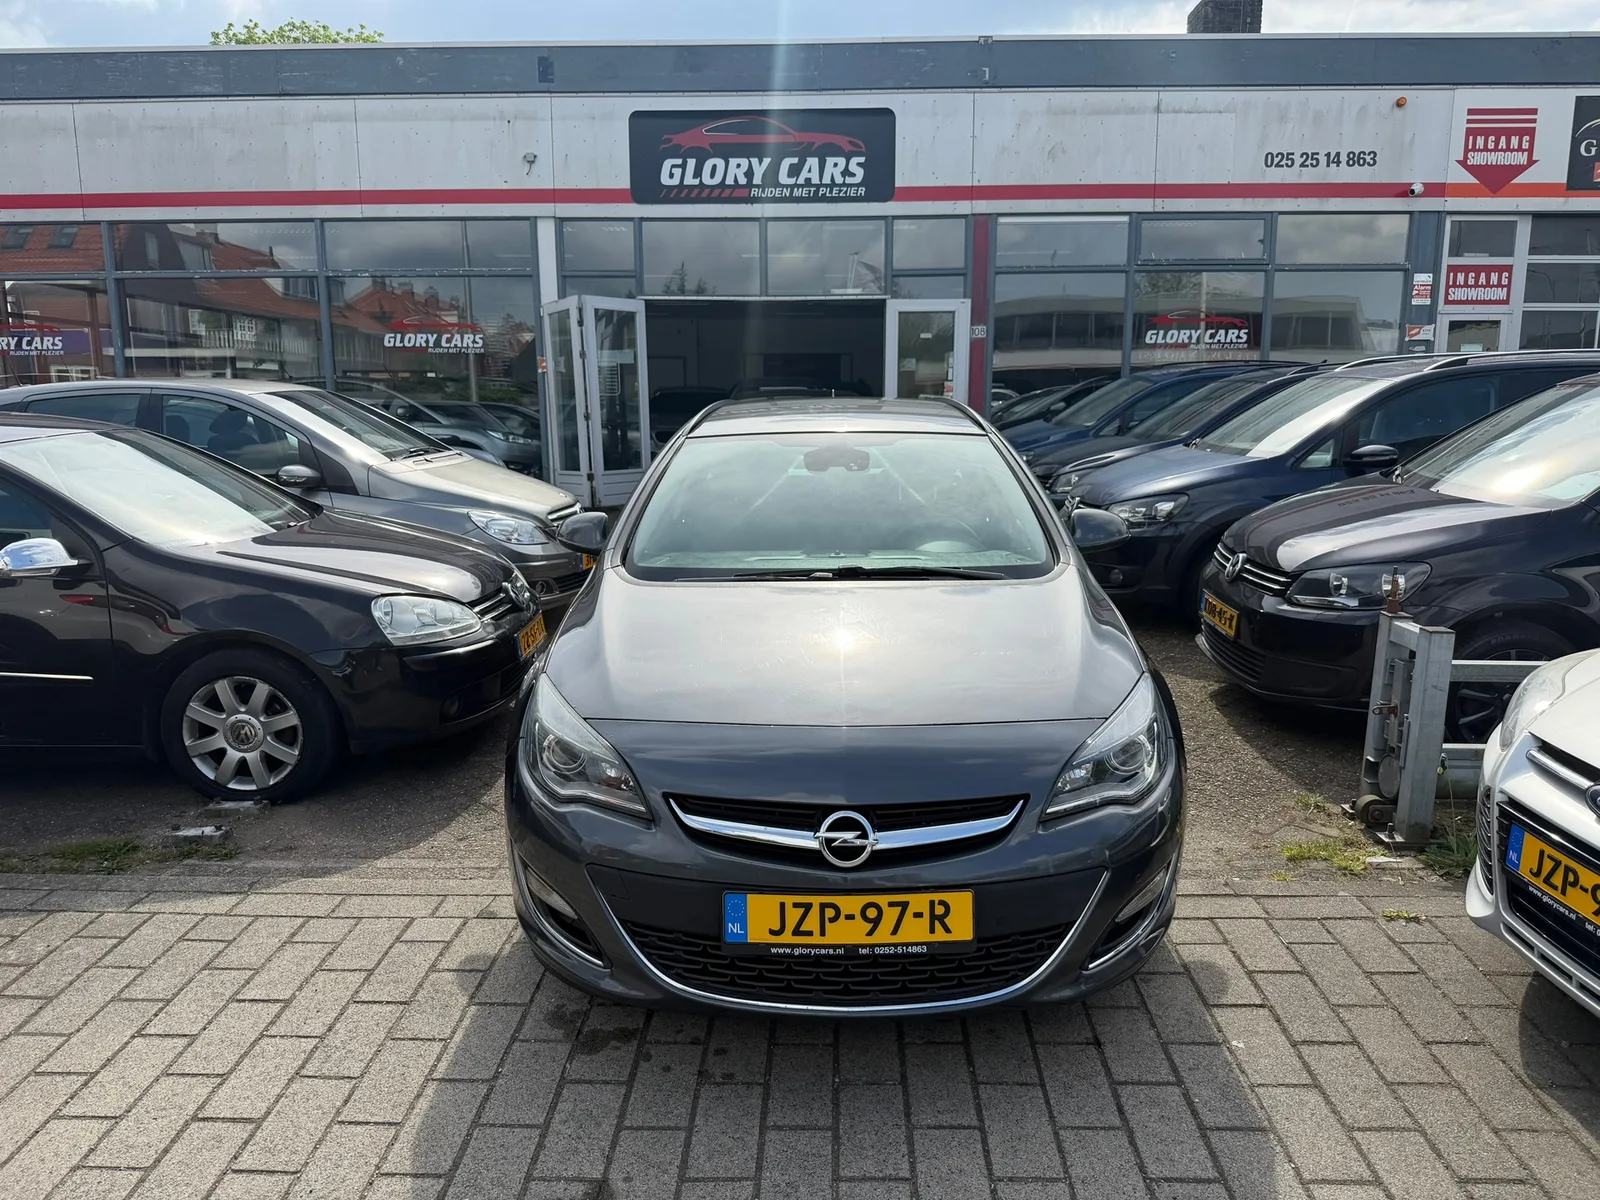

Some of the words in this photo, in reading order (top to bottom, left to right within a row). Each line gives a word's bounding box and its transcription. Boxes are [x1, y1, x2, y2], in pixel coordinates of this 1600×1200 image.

[1468, 136, 1530, 149] INGANG
[1264, 152, 1295, 168] 025
[1299, 152, 1320, 168] 25
[1324, 151, 1342, 167] 14
[1346, 151, 1377, 167] 863
[1467, 151, 1529, 165] SHOWROOM
[660, 157, 771, 185] GLORY
[778, 157, 866, 184] CARS
[750, 188, 791, 198] RIJDEN
[793, 187, 816, 197] MET
[818, 187, 866, 197] PLEZIER
[1449, 272, 1509, 285] INGANG
[1448, 287, 1507, 300] SHOWROOM
[971, 327, 986, 336] 108
[1145, 329, 1202, 344] GLORY
[1204, 329, 1249, 343] CARS
[21, 336, 63, 350] CARS
[383, 333, 438, 348] GLORY
[441, 333, 484, 348] CARS
[1508, 849, 1519, 864] NL
[1528, 884, 1577, 920] www.glorycars.nl
[728, 922, 744, 934] NL
[768, 899, 953, 938] JZP-97-R
[770, 946, 844, 956] www.glorycars.nl
[858, 946, 873, 955] tel:
[874, 945, 927, 954] 0252-514863
